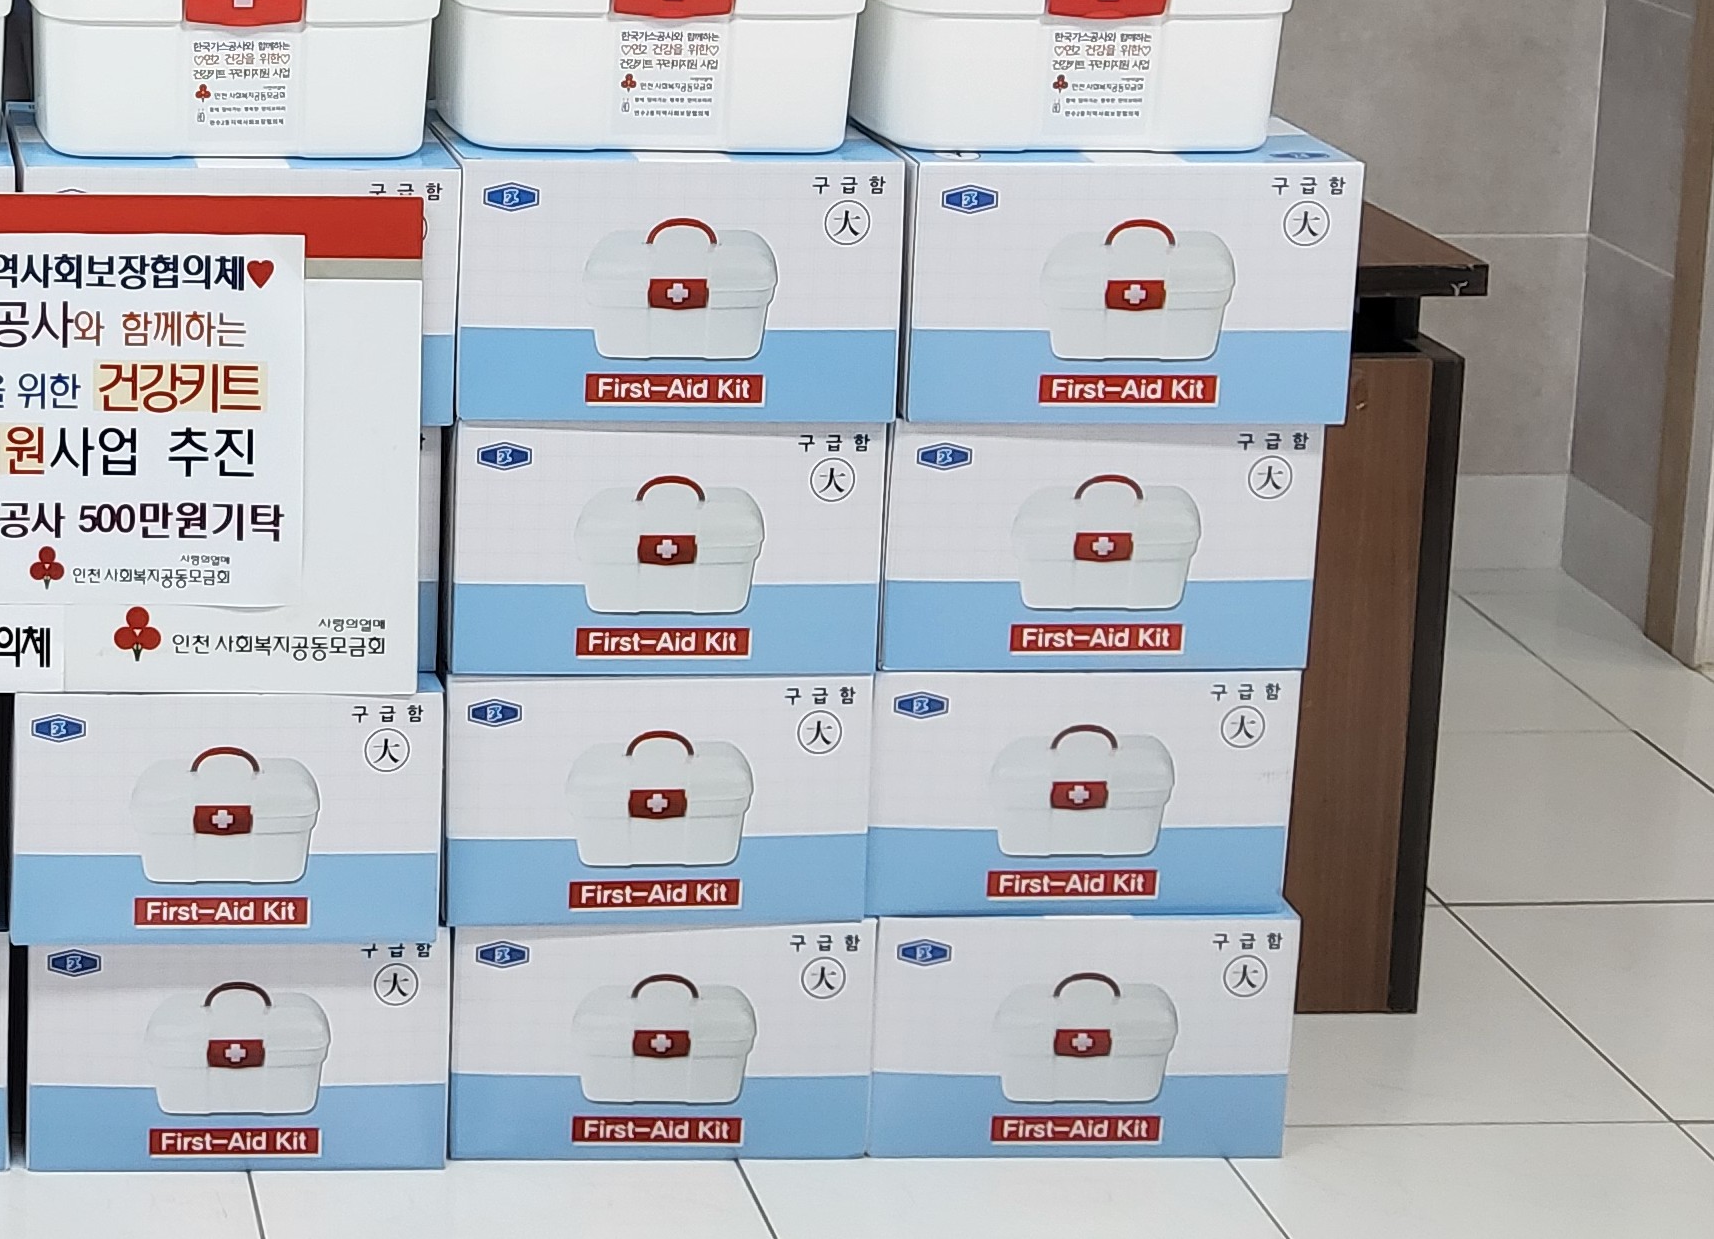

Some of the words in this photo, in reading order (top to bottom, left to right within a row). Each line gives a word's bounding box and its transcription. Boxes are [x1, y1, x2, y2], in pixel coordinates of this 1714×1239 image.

[832, 209, 861, 237] 大
[1292, 210, 1321, 238] 大
[121, 310, 247, 348] 함께하는
[17, 372, 82, 410] 위한
[98, 363, 262, 414] 건강키트
[598, 377, 709, 399] First-Aid
[717, 378, 750, 399] Kit
[1051, 378, 1163, 400] First-Aid
[1171, 378, 1204, 400] Kit
[167, 426, 255, 478] 추진
[818, 467, 846, 494] 大
[1256, 465, 1284, 491] 大
[78, 502, 285, 543] 500만원기탁
[72, 567, 101, 584] 인천
[103, 568, 230, 589] 사회복지공동모금회
[172, 634, 210, 655] 인천
[214, 634, 385, 662] 사회복지공동모금회
[588, 631, 696, 652] First-Aid
[705, 631, 737, 652] Kit
[1022, 627, 1130, 648] First-Aid
[1137, 627, 1170, 648] Kit
[806, 720, 833, 746] 大
[1230, 714, 1256, 740] 大
[372, 737, 401, 764] 大
[580, 883, 688, 904] First-Aid
[696, 882, 727, 903] Kit
[998, 873, 1105, 894] First-Aid
[1113, 873, 1144, 893] Kit
[146, 901, 255, 922] First-Aid
[263, 901, 296, 921] Kit
[382, 972, 410, 998] 大
[810, 965, 837, 991] 大
[1232, 964, 1259, 989] 大
[161, 1131, 267, 1151] First-Aid
[276, 1131, 307, 1150] Kit
[584, 1120, 690, 1140] First-Aid
[698, 1120, 729, 1140] Kit
[1002, 1119, 1109, 1138] First-Aid
[1116, 1119, 1148, 1138] Kit
